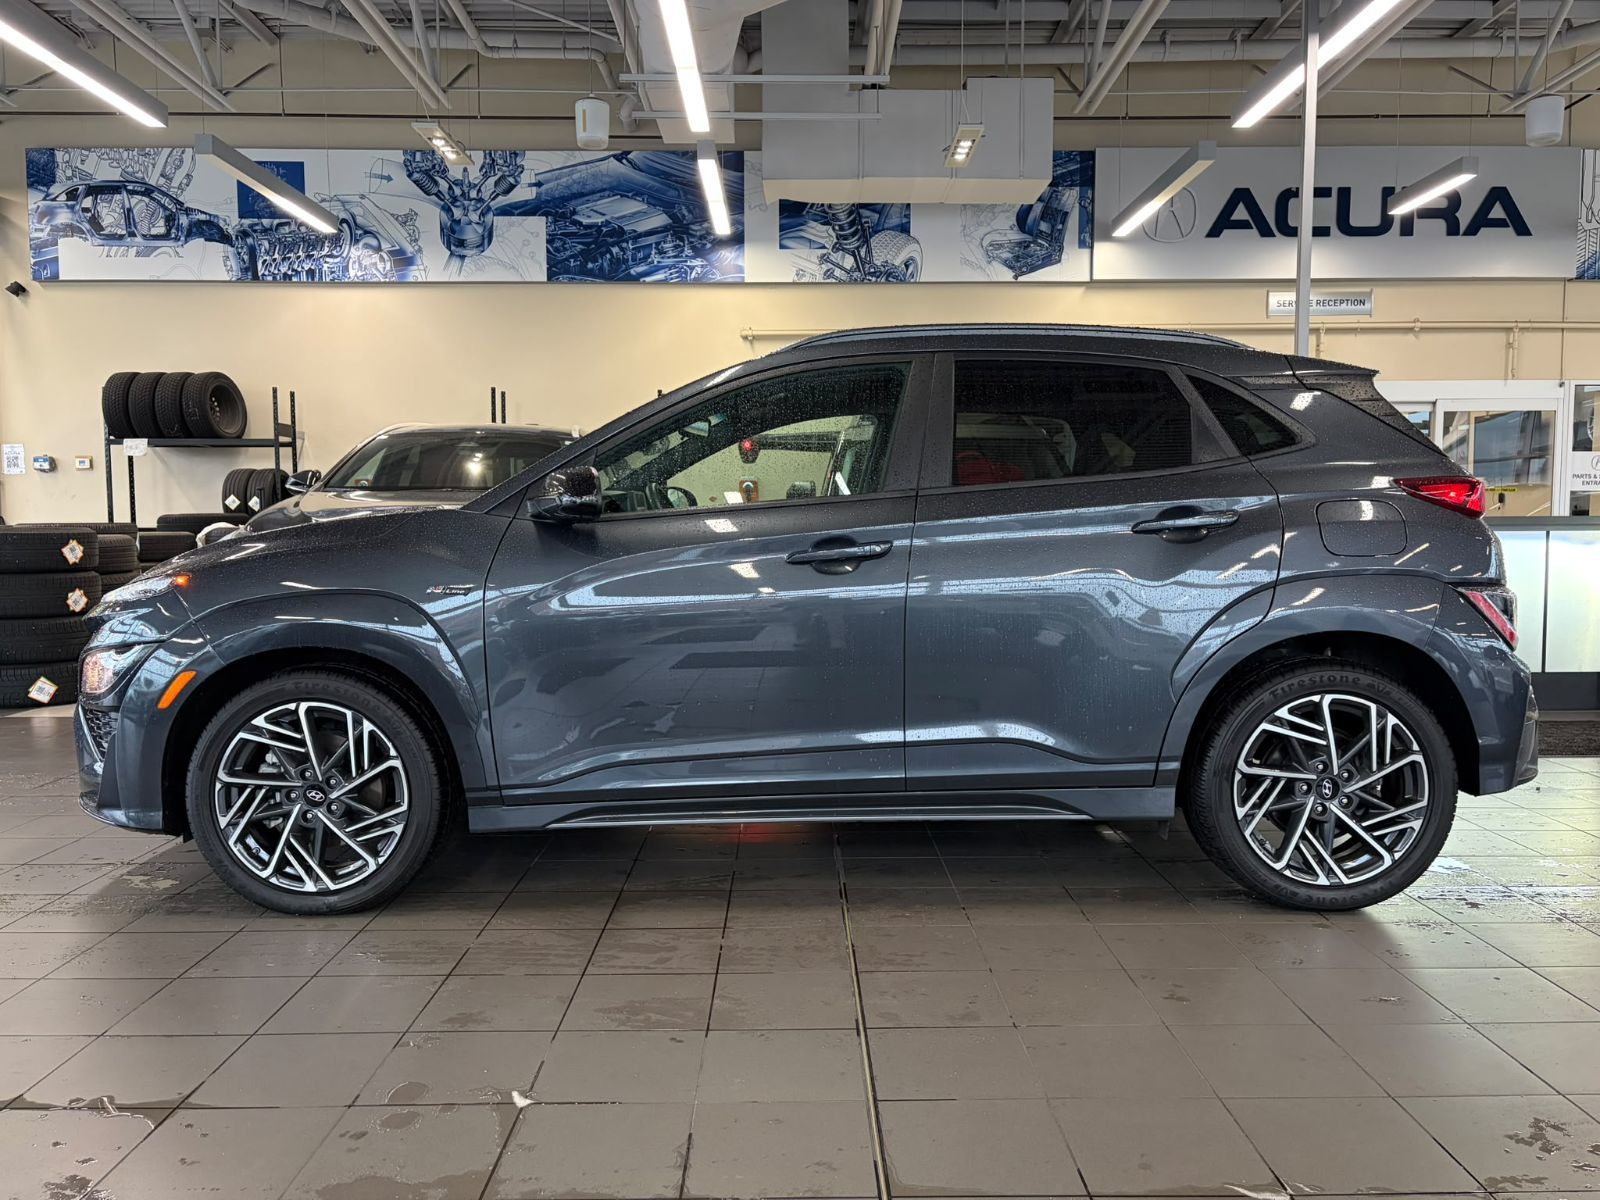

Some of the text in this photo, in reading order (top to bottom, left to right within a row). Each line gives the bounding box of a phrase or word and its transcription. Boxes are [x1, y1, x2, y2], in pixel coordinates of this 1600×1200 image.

[1204, 186, 1533, 238] ACURA
[1315, 298, 1366, 307] RECEPTION
[1270, 674, 1361, 698] Firestone
